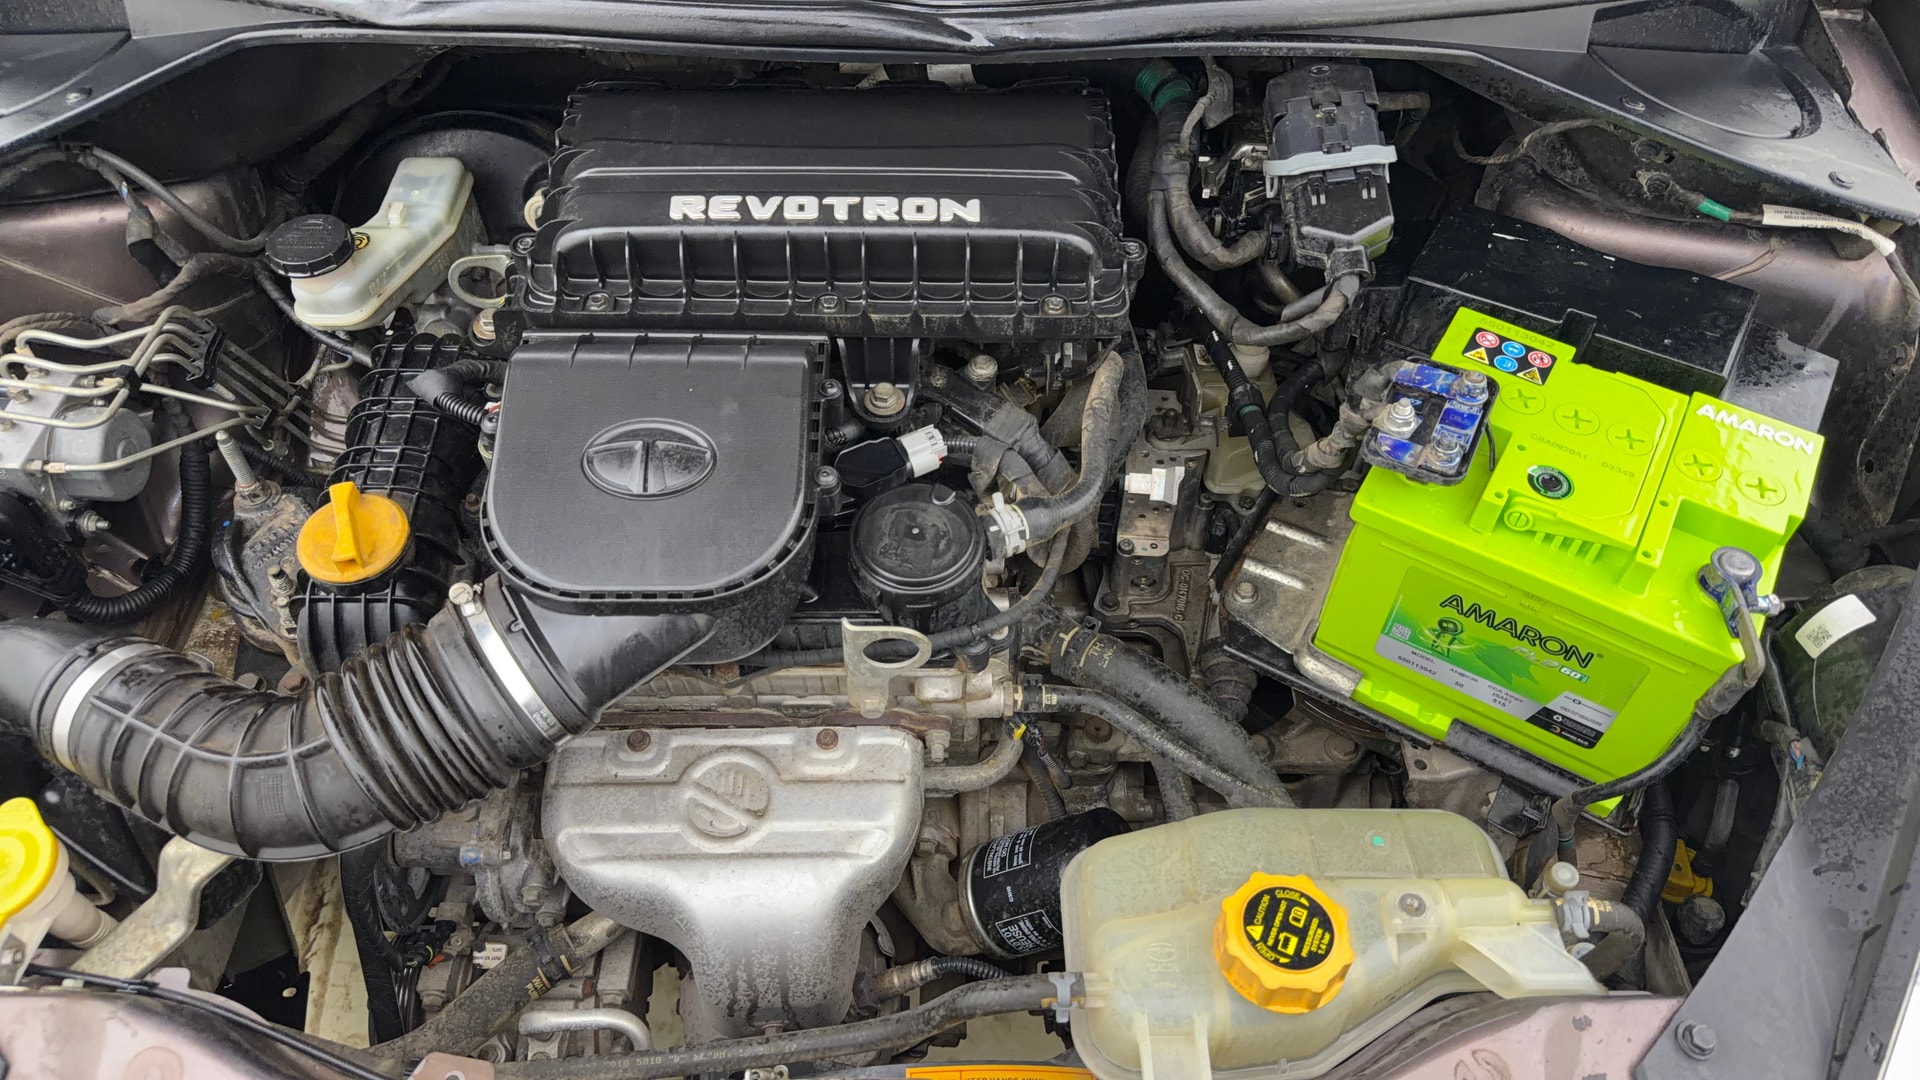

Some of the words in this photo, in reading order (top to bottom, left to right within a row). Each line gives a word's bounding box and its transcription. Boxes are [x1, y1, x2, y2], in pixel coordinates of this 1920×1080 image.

[670, 195, 981, 222] REVOTRON
[1696, 404, 1815, 455] AMARON
[1440, 594, 1595, 669] AMARON
[1397, 655, 1438, 677] 550113042
[1410, 650, 1436, 665] MODEL
[1454, 680, 1465, 690] 50
[1493, 698, 1507, 708] 515
[1274, 889, 1301, 899] CLOSE
[1254, 894, 1271, 925] CAUTION
[1265, 926, 1278, 946] NEVER
[1272, 911, 1284, 927] OPEN
[1278, 899, 1287, 912] HOT
[1311, 927, 1324, 952] SYSTEM
